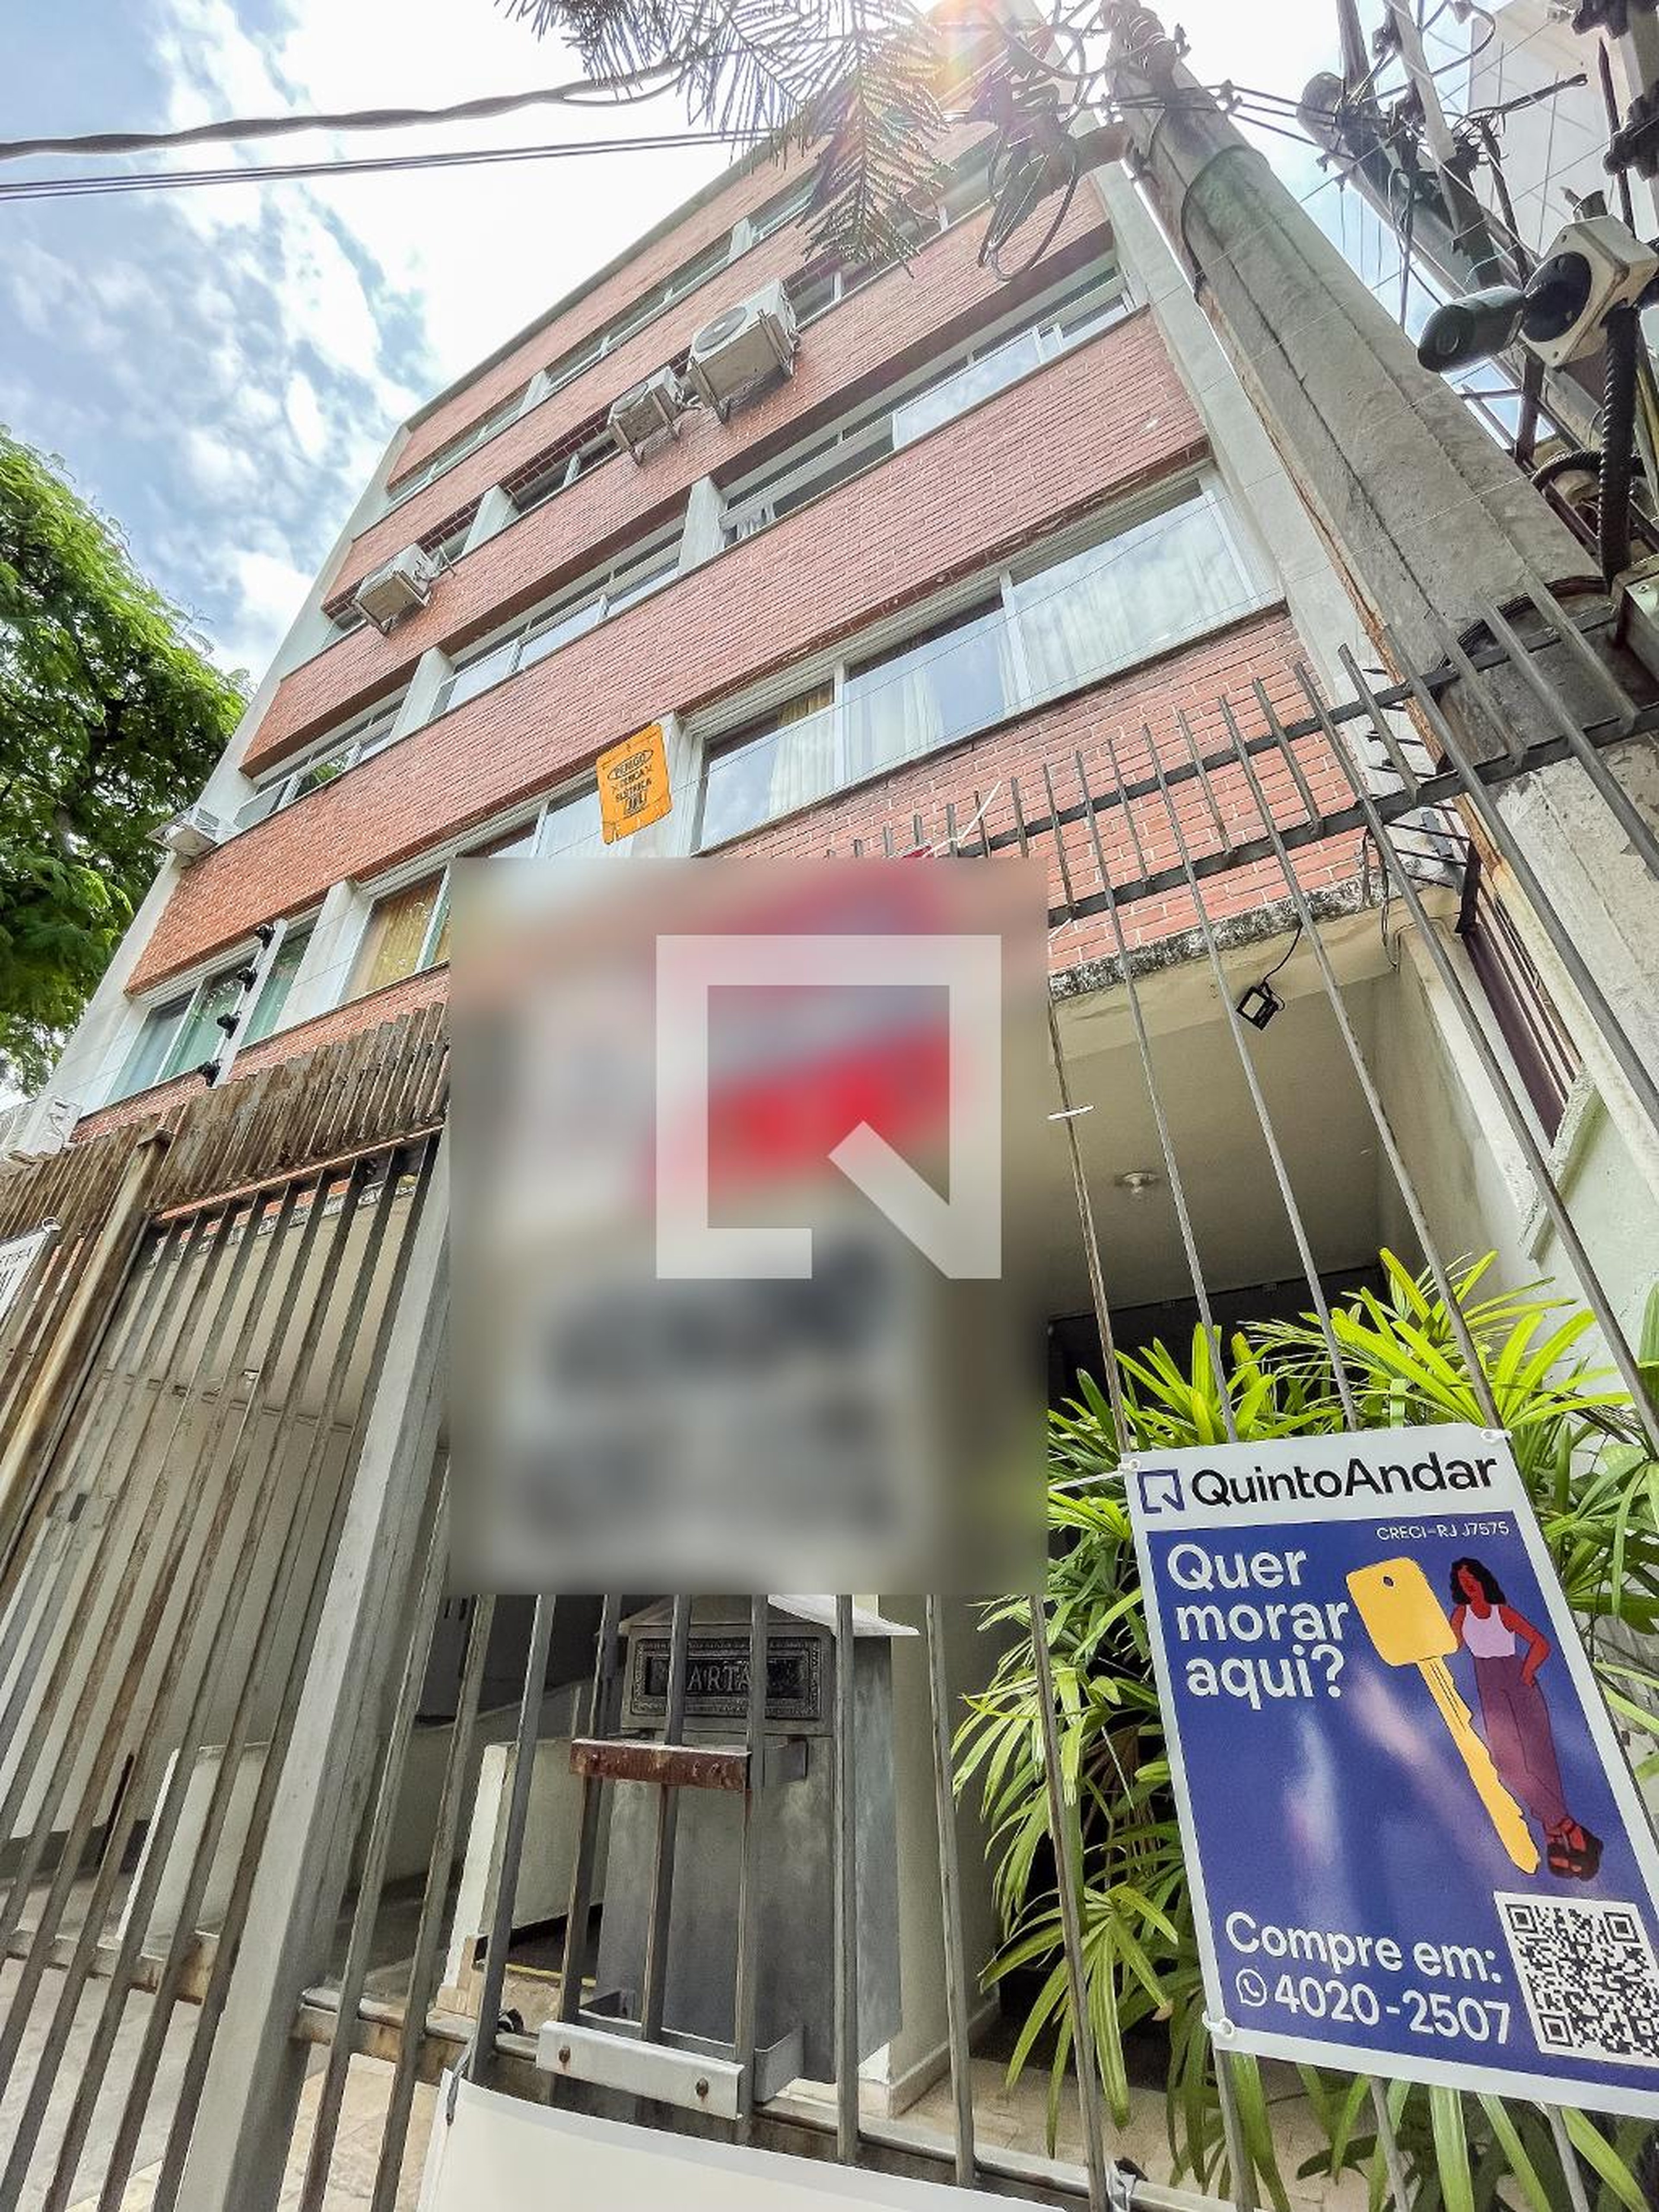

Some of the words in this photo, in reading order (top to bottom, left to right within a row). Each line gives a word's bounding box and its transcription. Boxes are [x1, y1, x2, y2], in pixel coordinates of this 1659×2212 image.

[1192, 1451, 1497, 1507] QuintoAndar
[1376, 1524, 1457, 1540] CRECI-RJ
[1462, 1521, 1510, 1536] J7575
[1167, 1543, 1307, 1592] Quer
[1176, 1600, 1349, 1642] morar
[1186, 1644, 1345, 1710] aqui?
[1226, 1911, 1403, 1974] Compre
[1413, 1942, 1502, 1983] em:
[1274, 1974, 1510, 2044] 4020-2507
